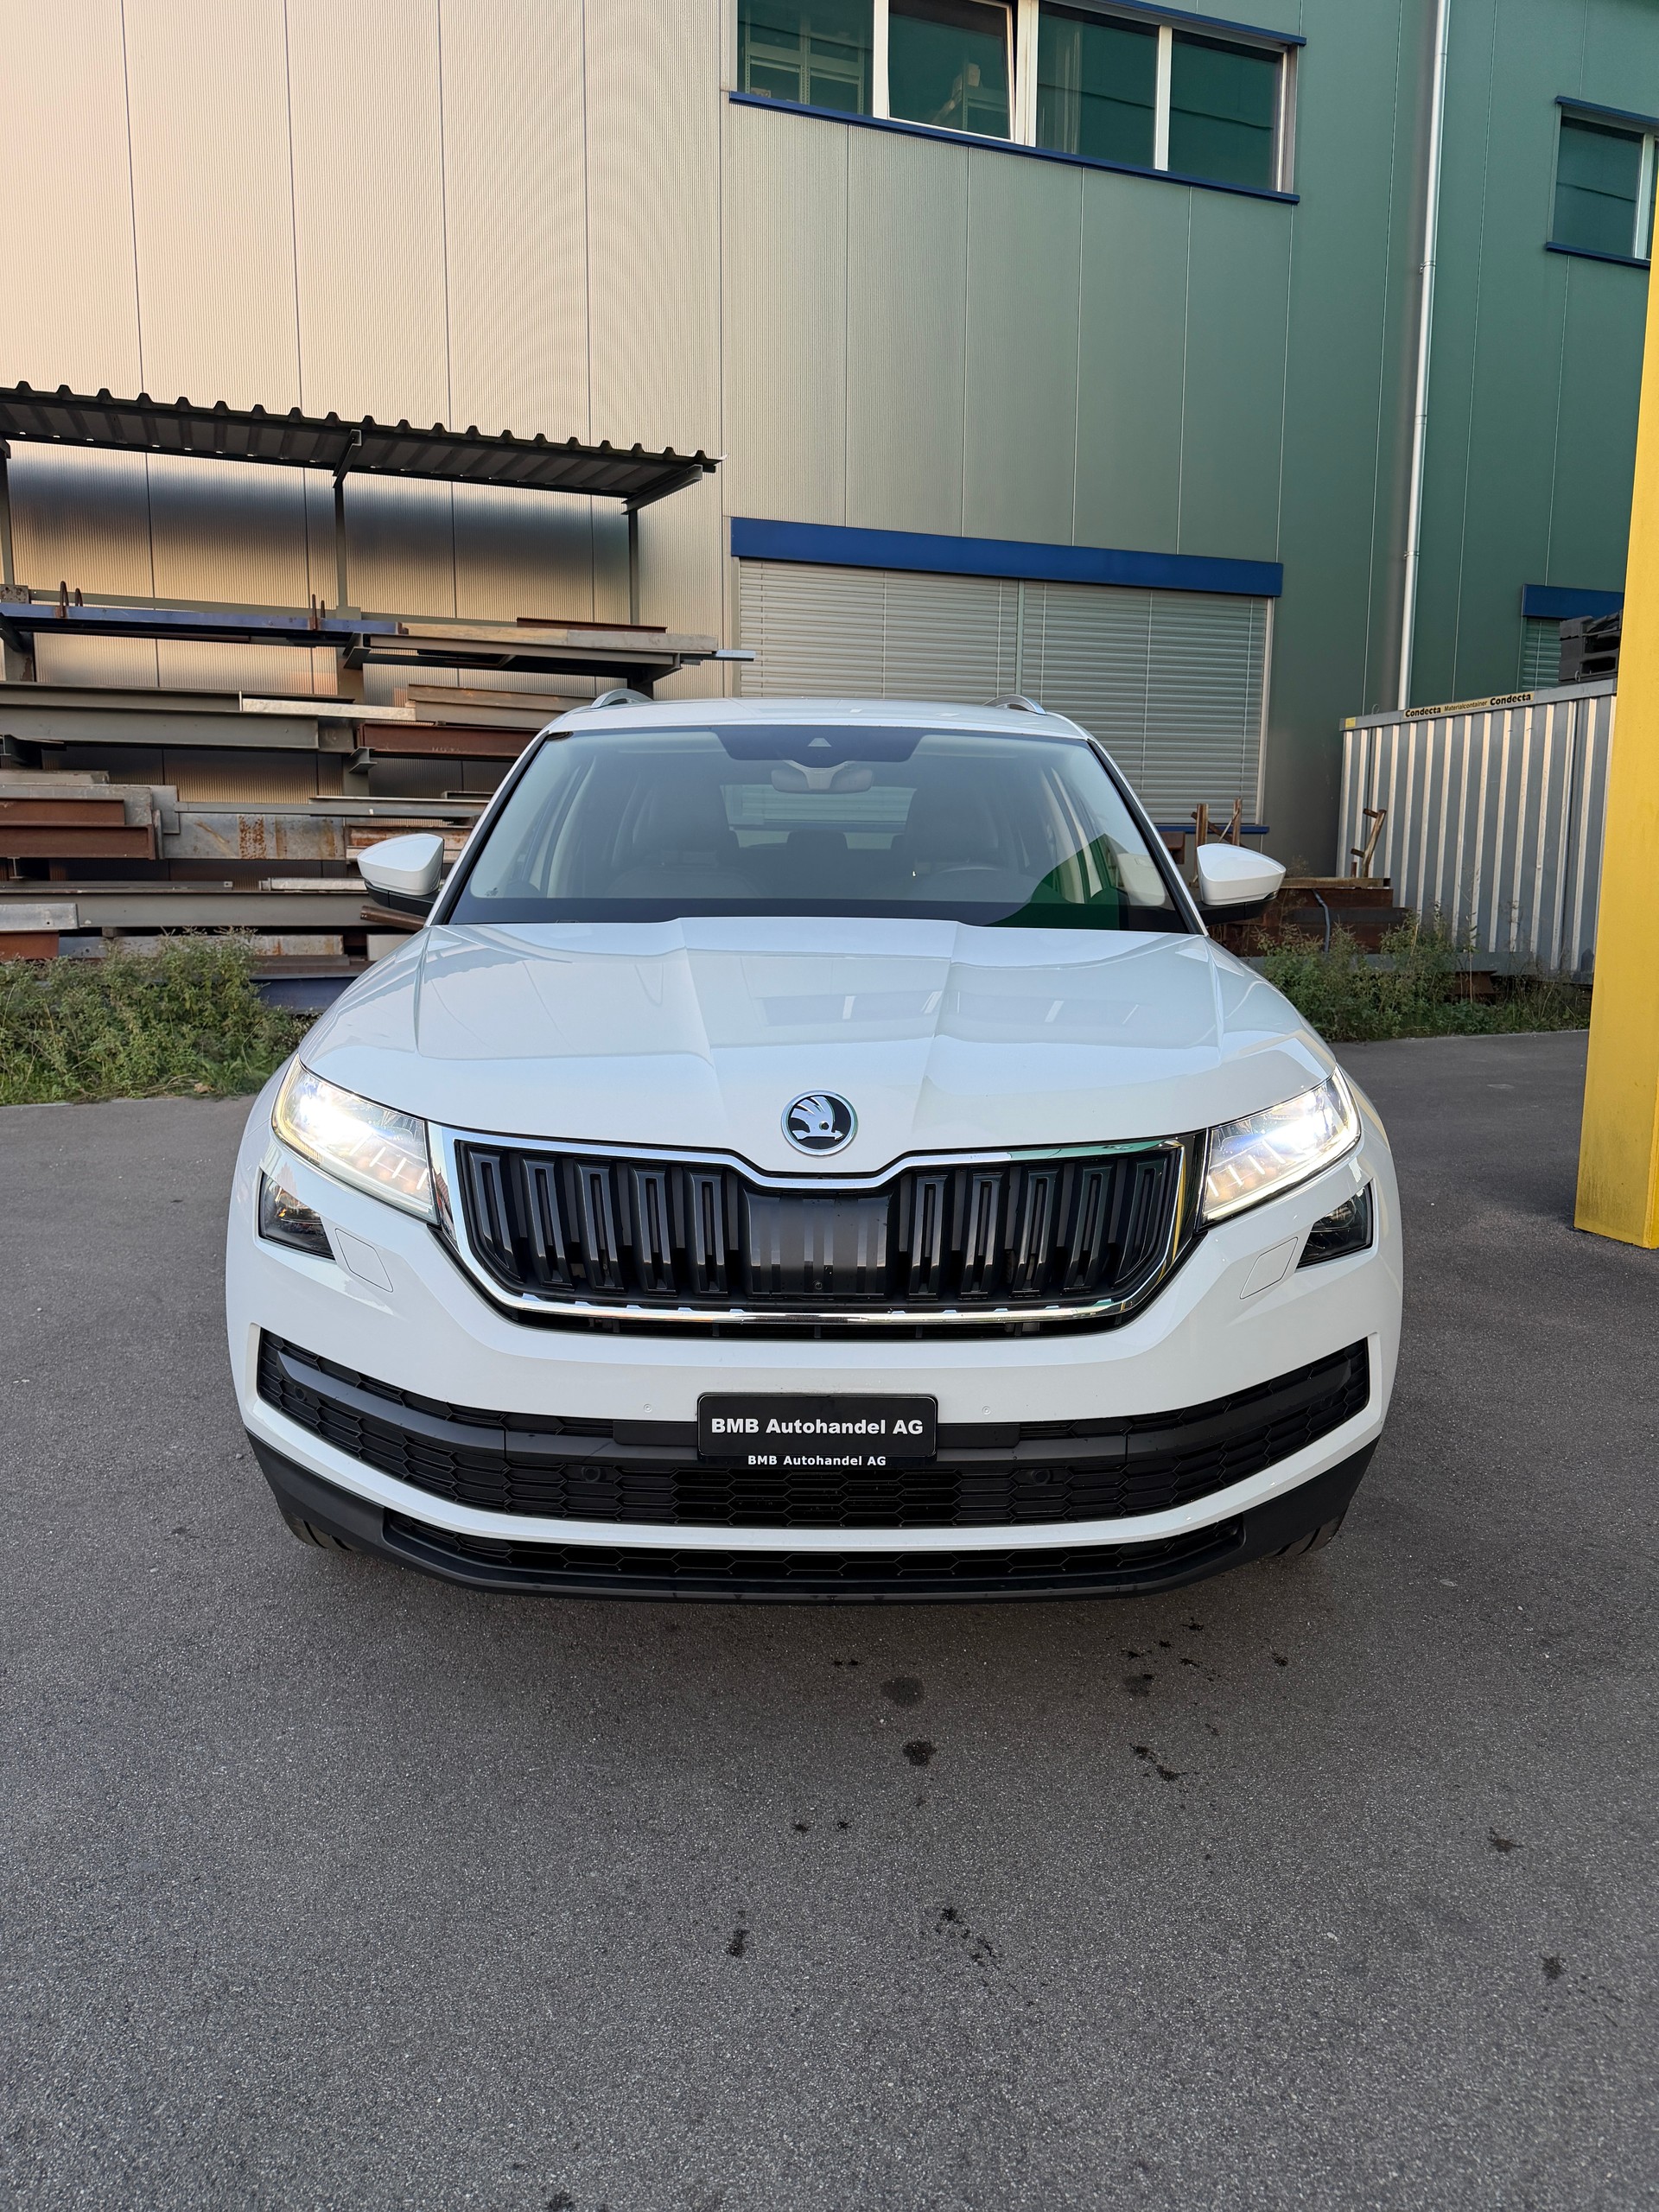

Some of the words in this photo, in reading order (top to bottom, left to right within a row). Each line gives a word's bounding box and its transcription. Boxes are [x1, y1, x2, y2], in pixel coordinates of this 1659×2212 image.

[1405, 706, 1441, 718] Condecta
[1444, 701, 1488, 712] Materialcontainer
[1490, 693, 1531, 706] Condecta
[711, 1418, 760, 1434] BMB
[766, 1418, 887, 1435] Autohandel
[892, 1419, 924, 1435] AG
[747, 1455, 778, 1465] BMB
[783, 1455, 862, 1466] Autohandel
[867, 1456, 887, 1466] AG
